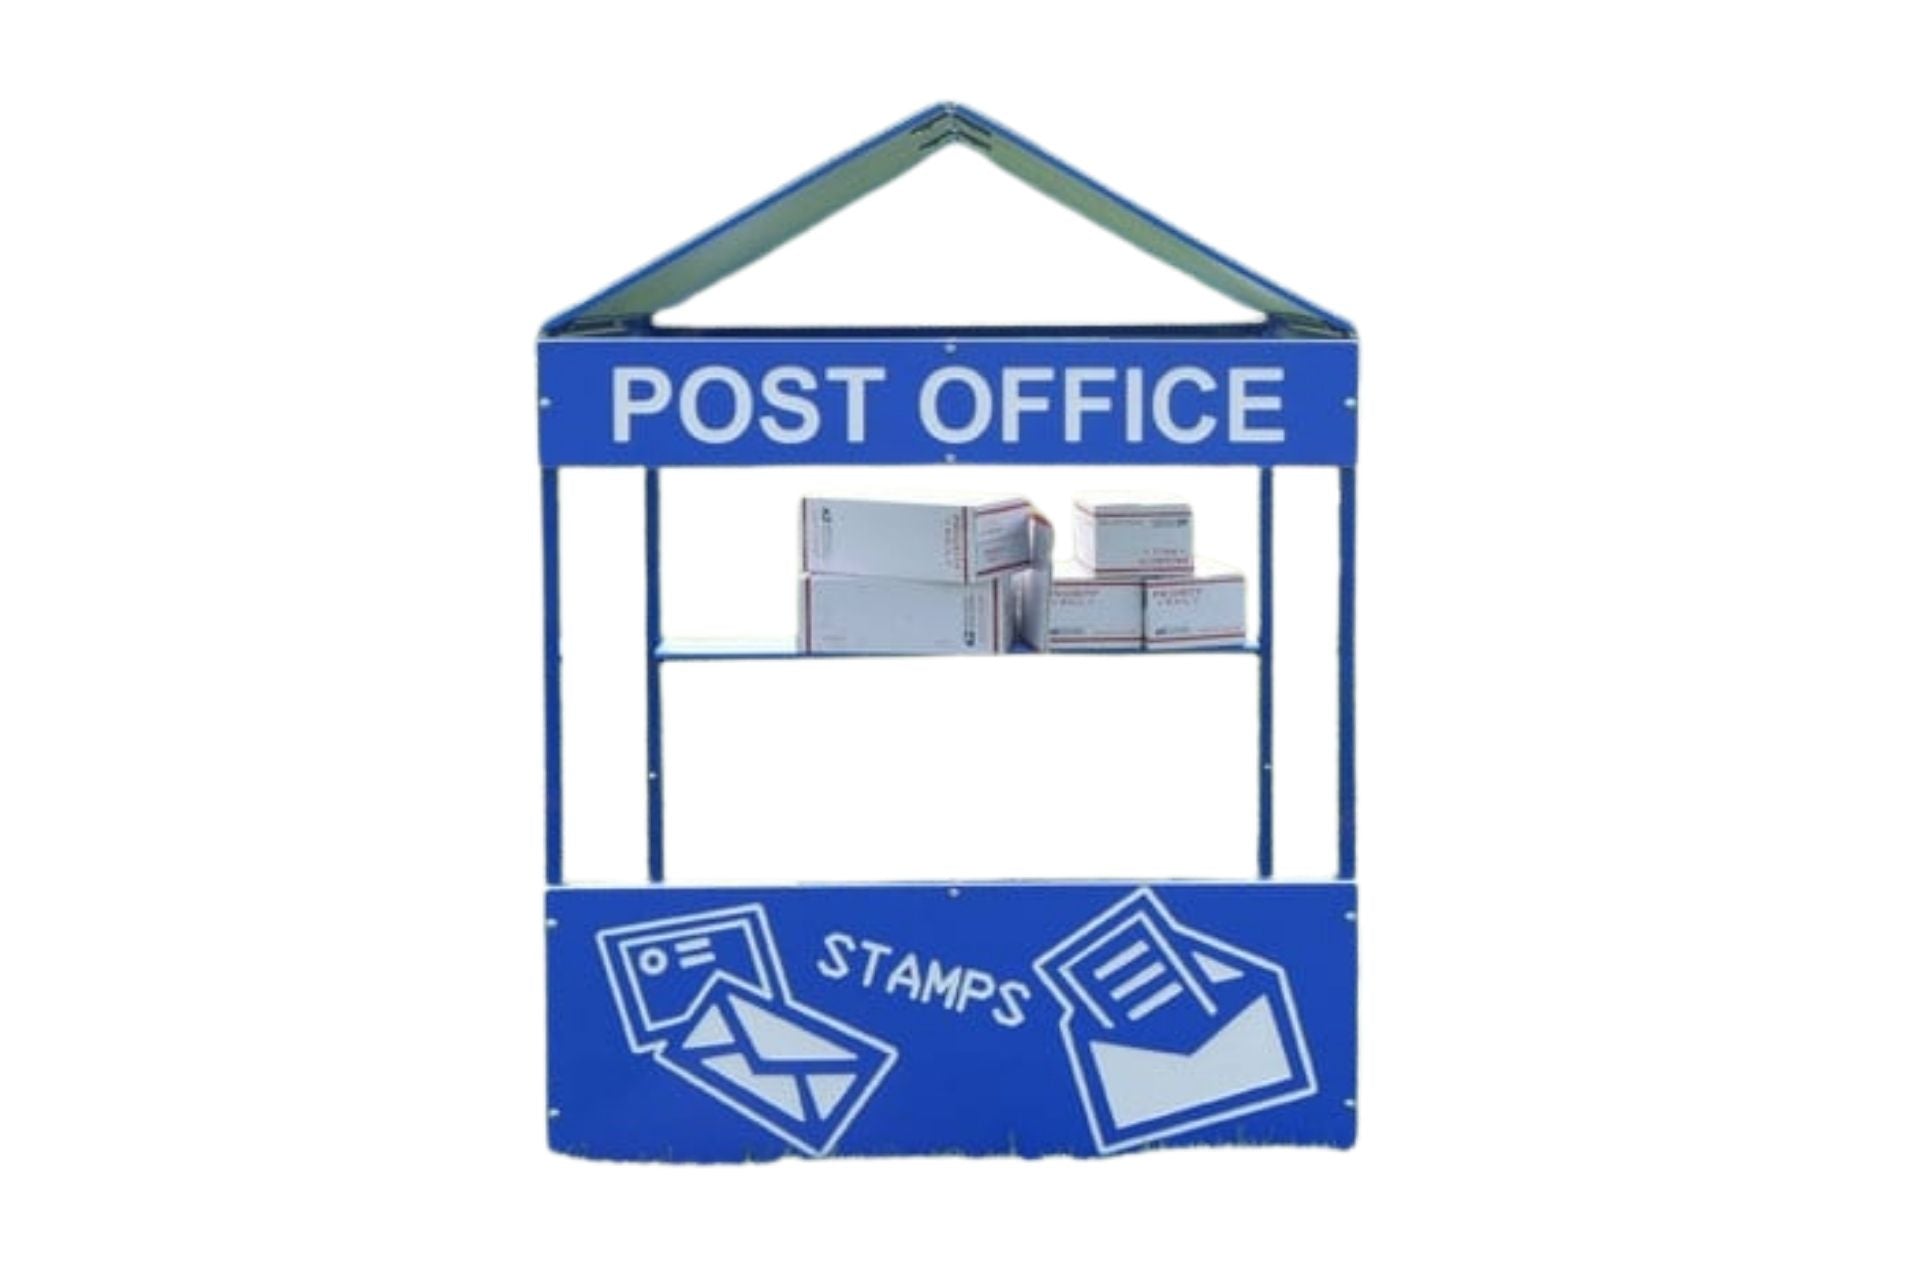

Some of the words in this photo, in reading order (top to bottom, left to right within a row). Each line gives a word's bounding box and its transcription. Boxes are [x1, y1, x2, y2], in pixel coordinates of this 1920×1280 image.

[614, 366, 885, 443] POST
[920, 367, 1284, 443] OFFICE
[818, 934, 1031, 1027] STAMPS
